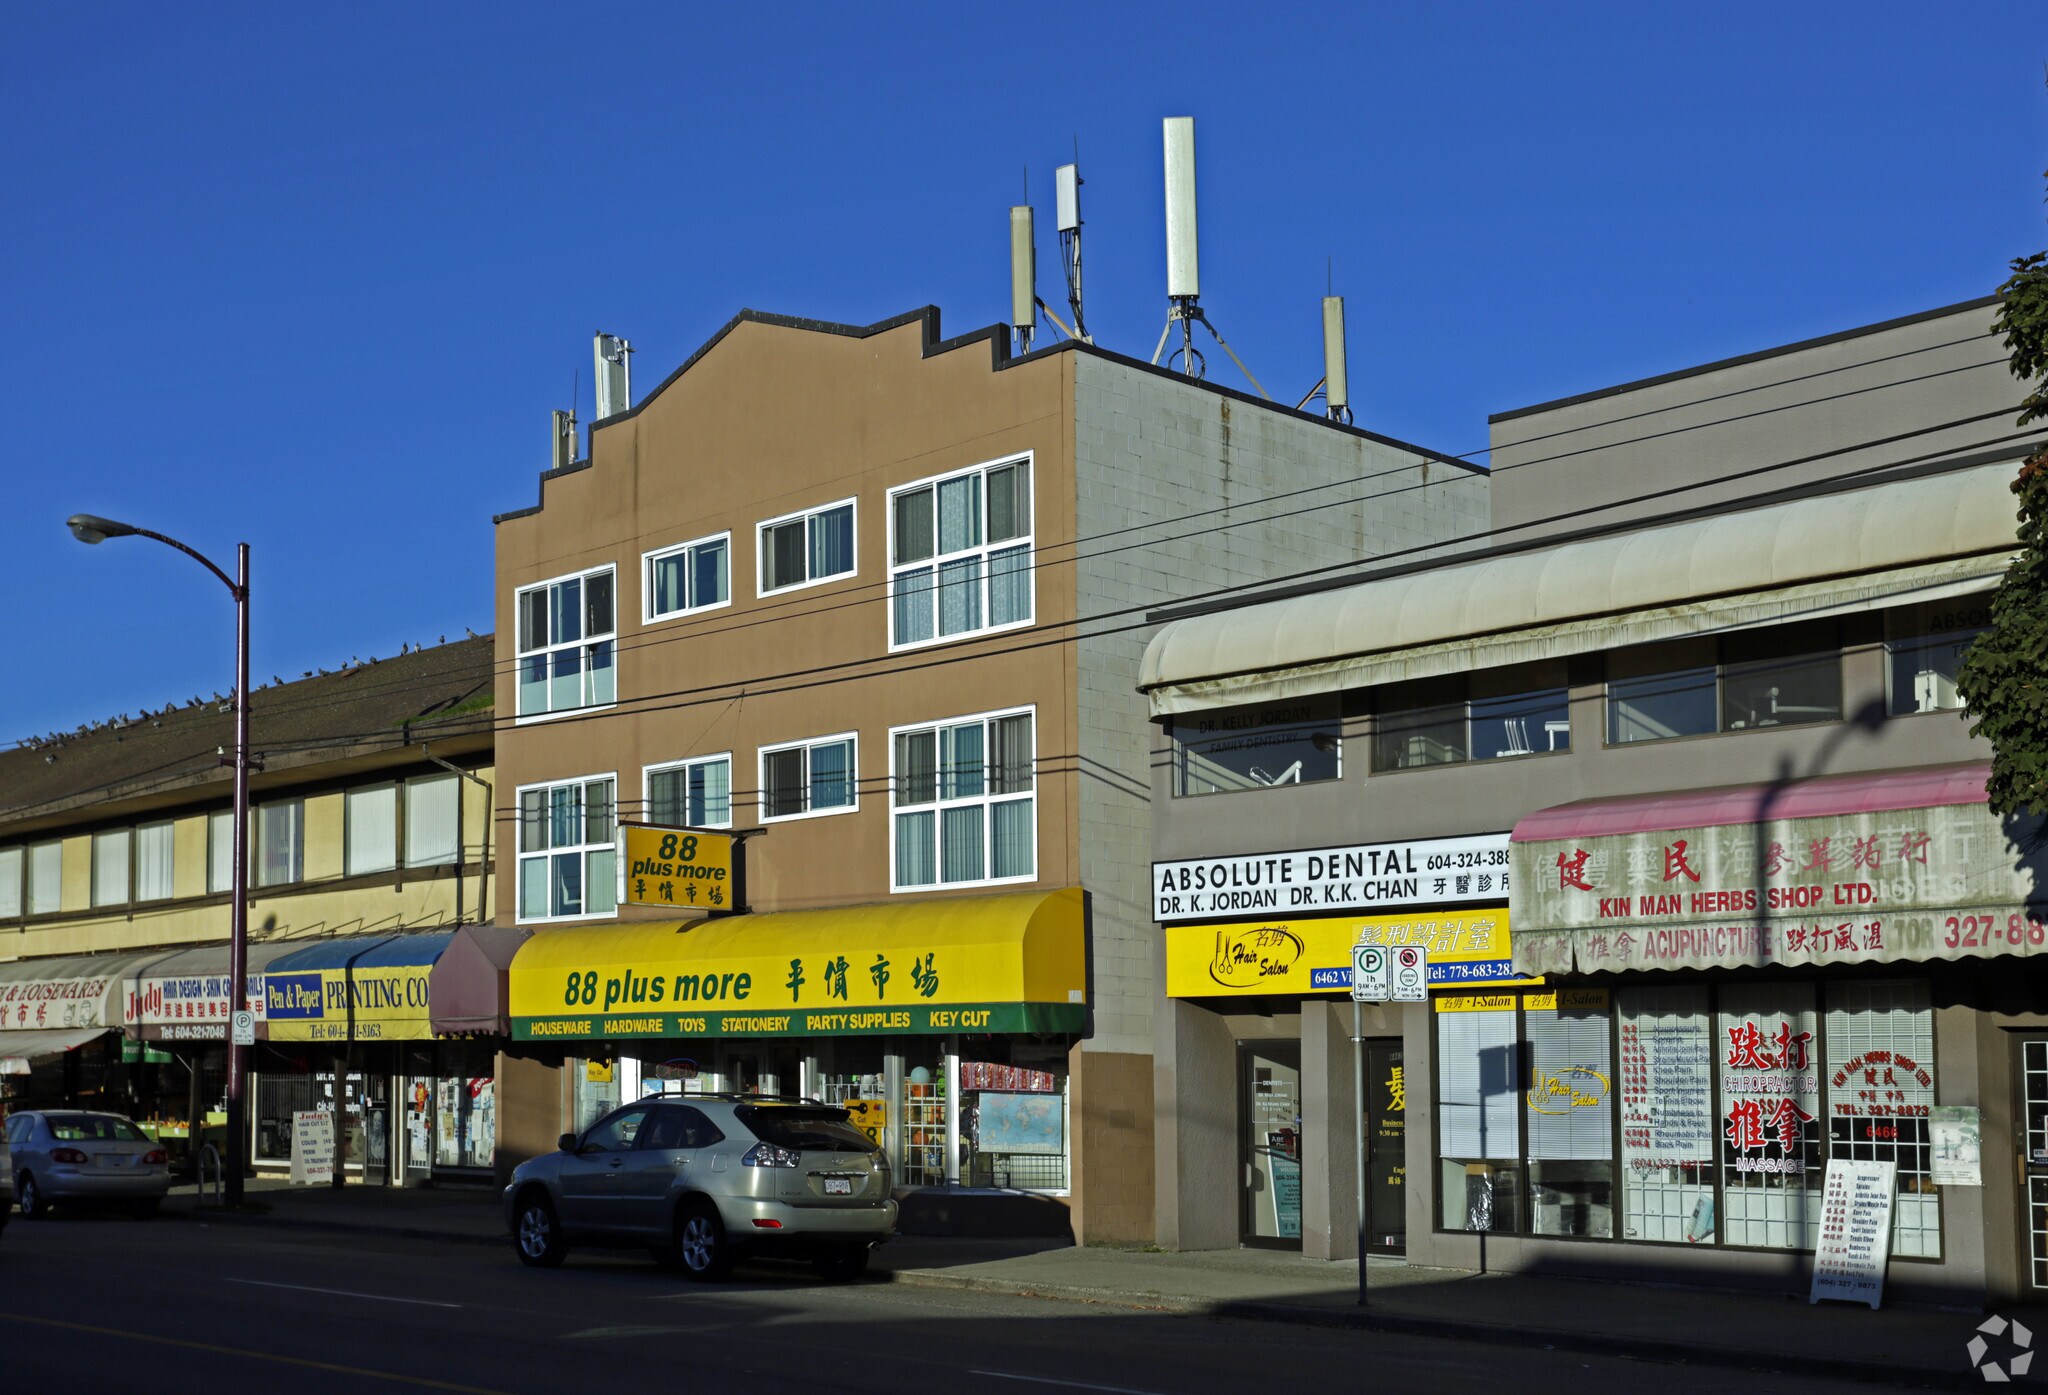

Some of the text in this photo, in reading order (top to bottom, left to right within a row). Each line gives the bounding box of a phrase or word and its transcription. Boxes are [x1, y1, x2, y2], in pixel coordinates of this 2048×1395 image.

[1199, 705, 1311, 734] DR. KELLY JORDAN
[1210, 732, 1298, 754] FAMILY DENTISTRY
[658, 833, 698, 862] 88
[631, 857, 726, 881] plus more
[1161, 858, 1292, 892] ABSOLUTE
[1308, 848, 1417, 881] DENTAL
[634, 878, 724, 905] 平價市場
[1160, 896, 1185, 914] DR.
[1191, 894, 1205, 912] K.
[1209, 889, 1277, 911] JORDAN
[1291, 886, 1318, 905] DR.
[1324, 883, 1357, 903] K.K.
[1363, 878, 1417, 900] CHAN
[1600, 896, 1631, 918] KIN
[1640, 894, 1682, 916] MAN
[1691, 889, 1757, 913] HERBS
[1767, 885, 1823, 909] SHOP
[1834, 882, 1878, 905] LTD.
[1232, 942, 1258, 965] Hair
[1644, 926, 1772, 960] ACUPUNCTURE
[1259, 957, 1289, 977] Salon
[1366, 955, 1377, 968] P
[785, 952, 939, 1003] 平價市場
[1315, 970, 1338, 984] 6462
[1427, 965, 1446, 979] Tel:
[163, 980, 178, 999] HAIR
[179, 979, 202, 998] DESIGN
[206, 978, 221, 998] SKIN
[268, 984, 320, 1014] Pen & Paper
[326, 977, 402, 1009] PRINTING
[564, 969, 752, 1012] 88 plus more
[126, 982, 162, 1022] Judy
[1472, 995, 1511, 1008] I-Salon
[310, 1024, 326, 1039] Tel:
[531, 1010, 991, 1036] HOUSEWARE HARDWARE TOYS STATIONERY PARTY SUPPLIES KEY CUT
[1727, 1020, 1812, 1070] 跌打
[656, 1063, 696, 1077] OPEN
[1547, 1077, 1571, 1096] Hair
[1723, 1075, 1816, 1092] CHIROPRACTOR
[1571, 1091, 1599, 1107] Salon
[1835, 1104, 1863, 1116] TEL:
[1726, 1097, 1815, 1153] 推拿
[1866, 1125, 1898, 1138] 6466
[1736, 1157, 1805, 1173] MASSAGE
